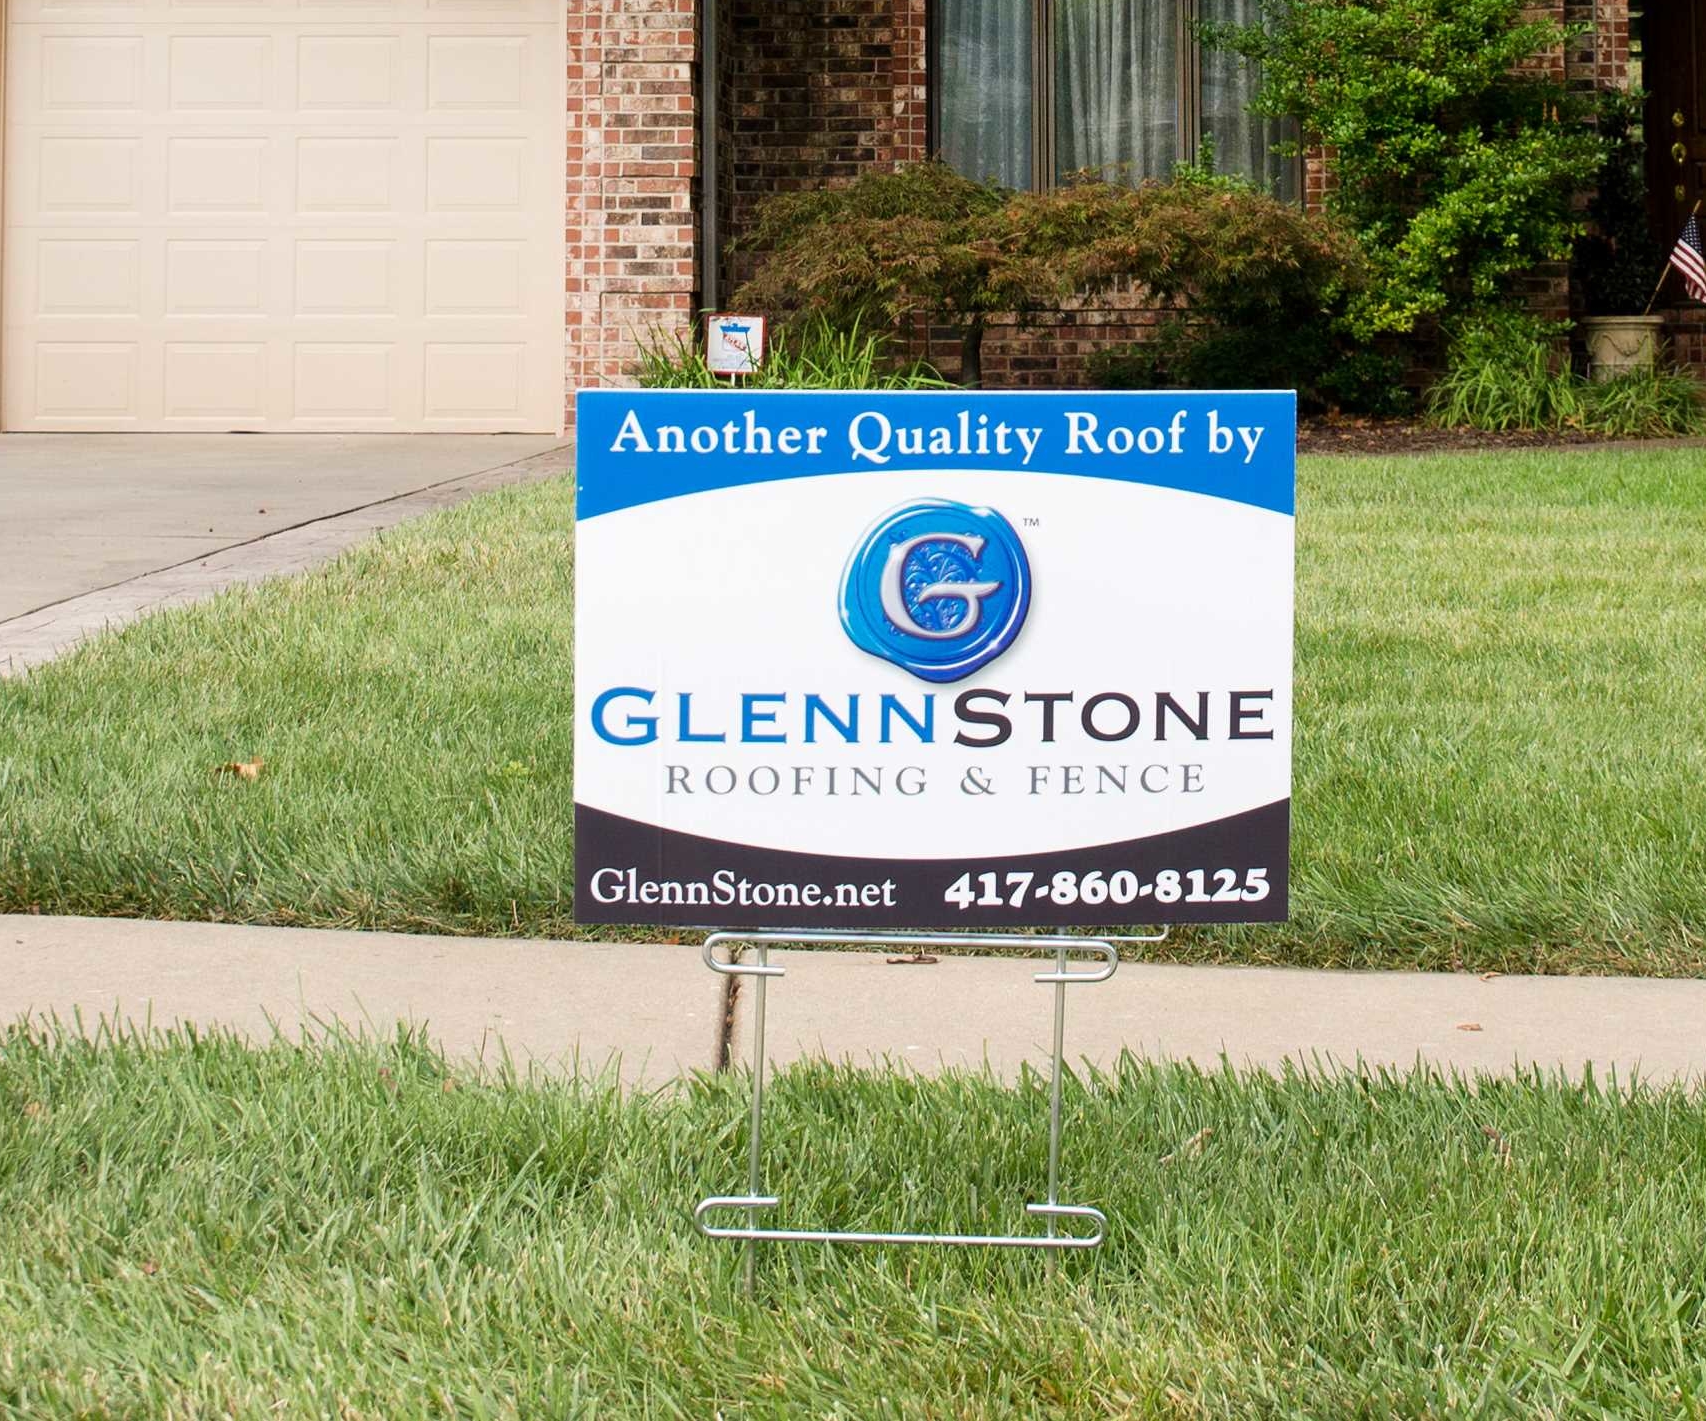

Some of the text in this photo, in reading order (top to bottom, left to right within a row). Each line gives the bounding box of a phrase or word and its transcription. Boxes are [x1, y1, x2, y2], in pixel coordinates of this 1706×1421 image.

[611, 411, 1265, 466] Another Quality Roof by
[880, 532, 1001, 639] G
[666, 764, 1206, 797] ROOFING & FENCE
[591, 868, 1271, 911] GlennStone.net 417-860-8125
